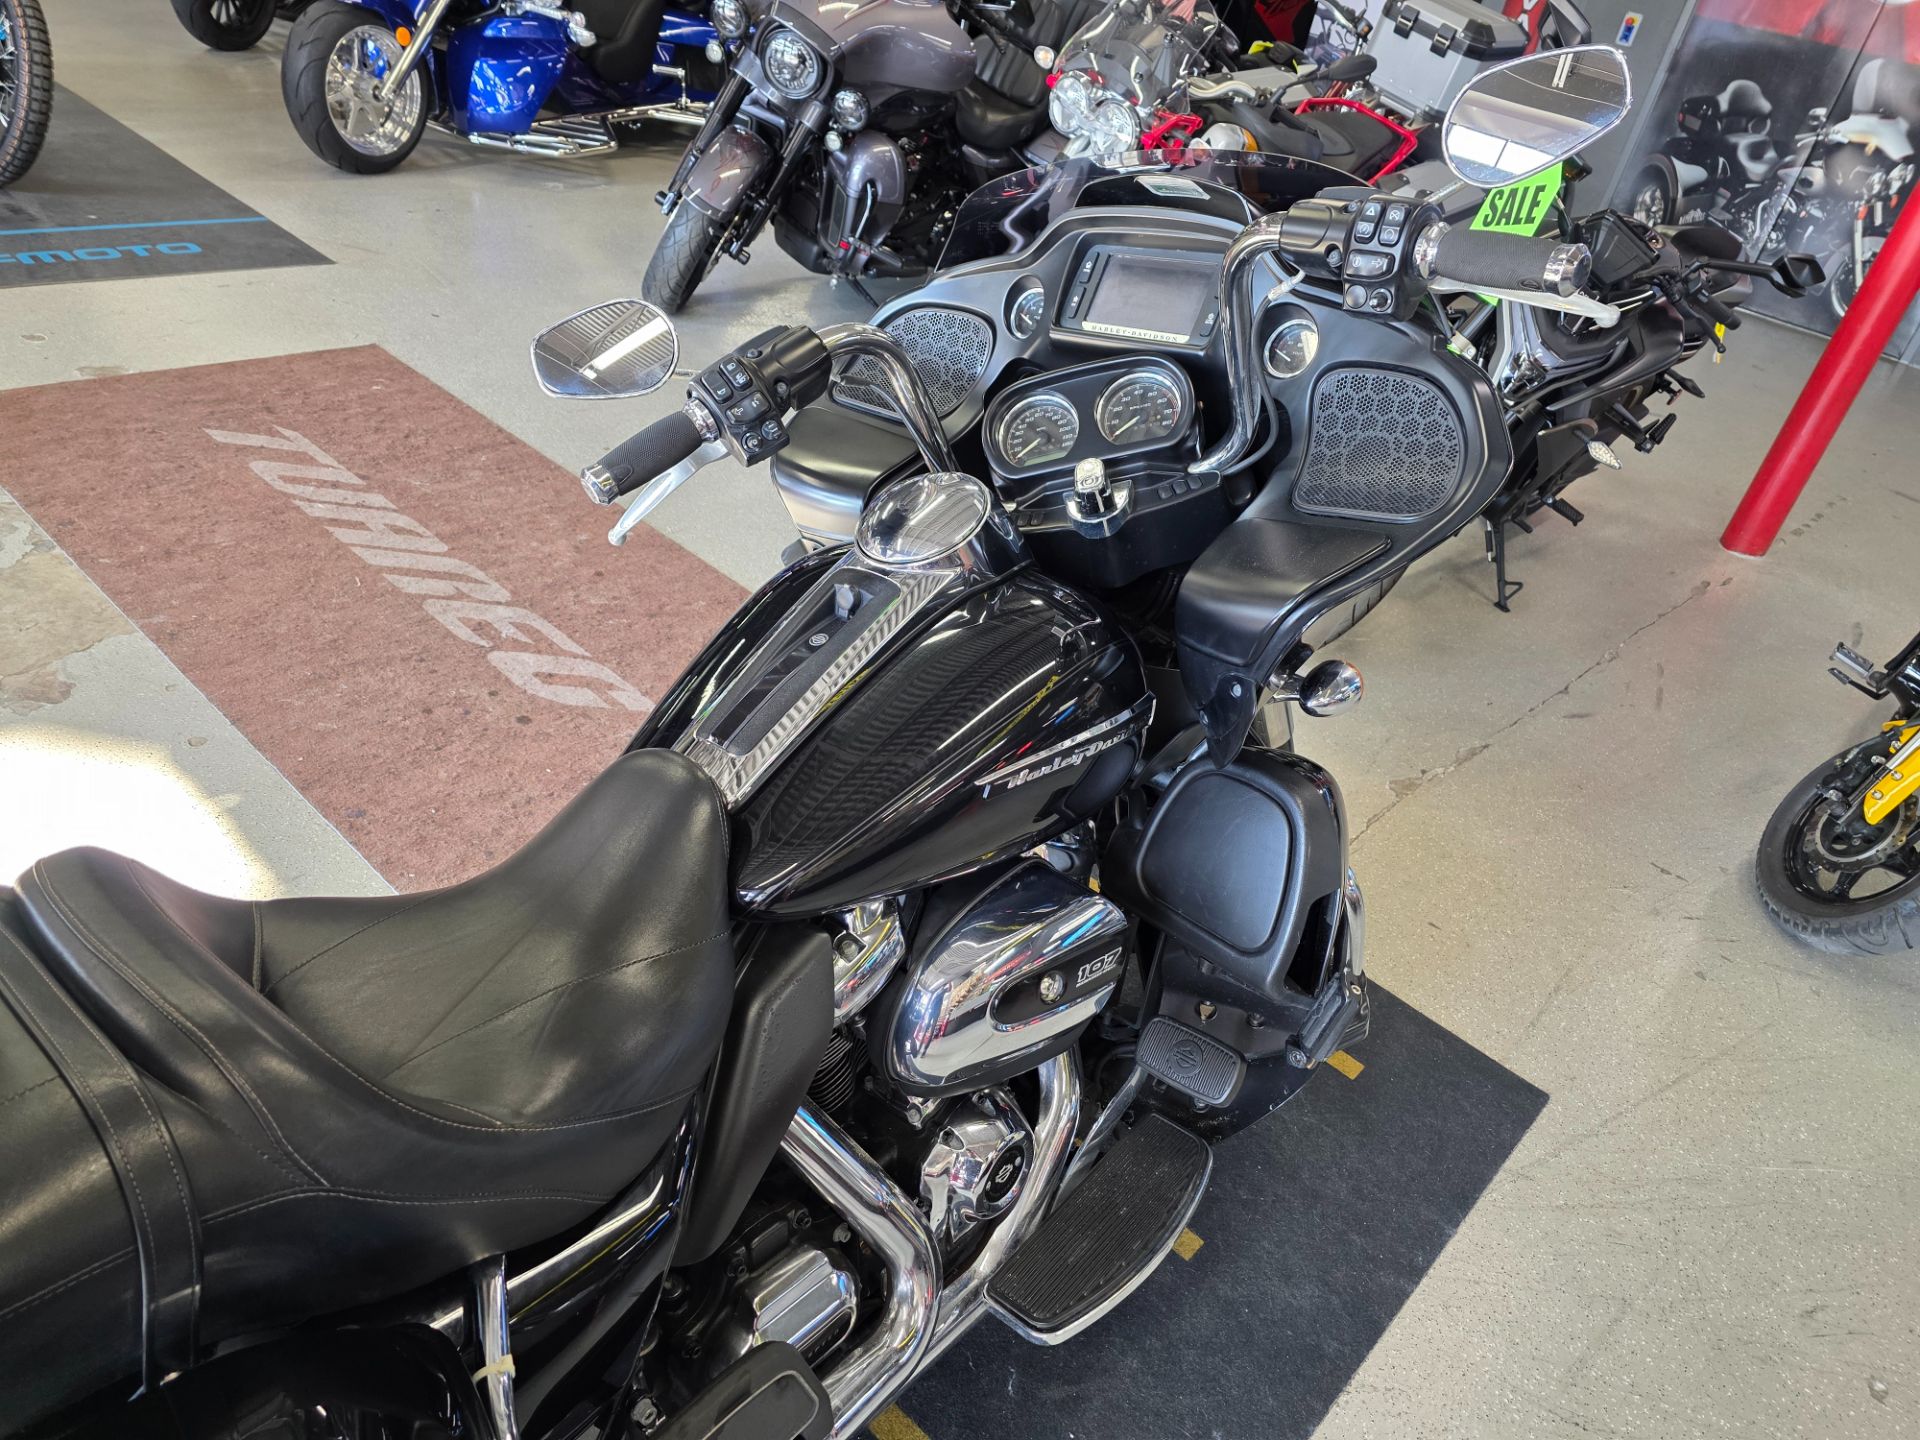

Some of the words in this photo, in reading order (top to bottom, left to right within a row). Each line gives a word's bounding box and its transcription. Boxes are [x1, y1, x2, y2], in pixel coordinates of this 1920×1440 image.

[1482, 183, 1548, 227] SALE
[1091, 325, 1178, 342] HARLEY-DAVIDSON
[203, 425, 657, 712] TUAREG
[1077, 946, 1123, 983] 107
